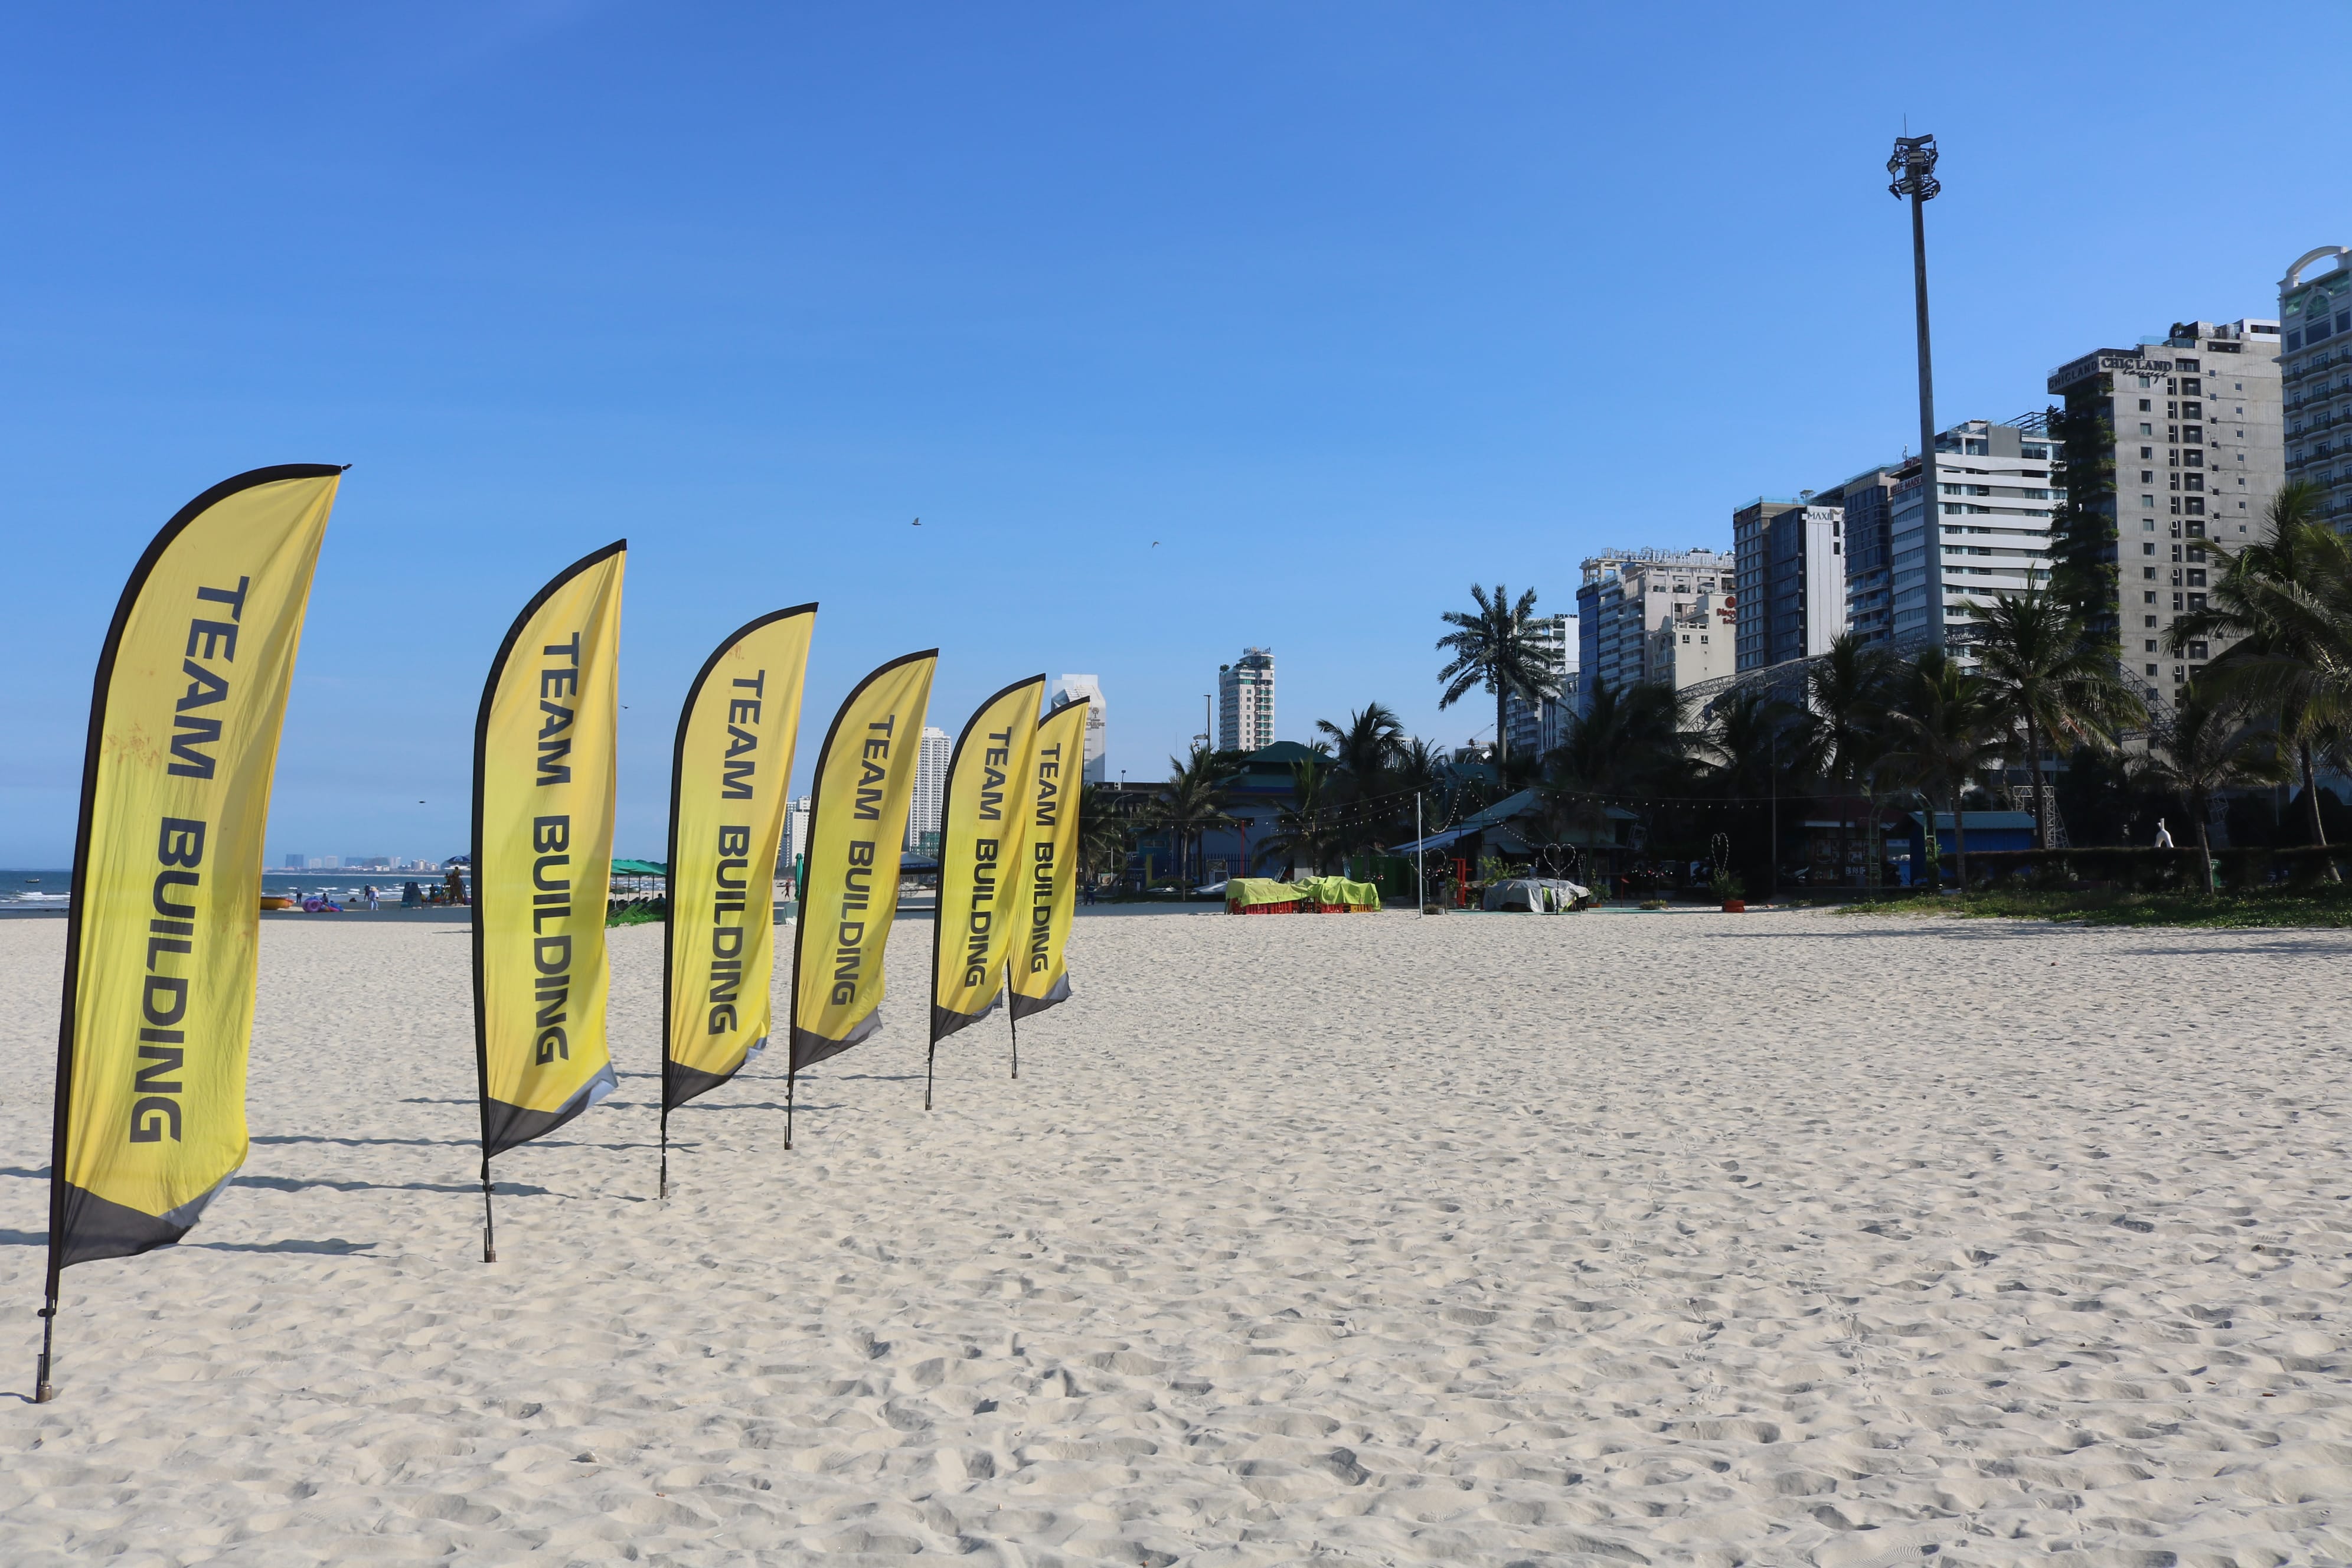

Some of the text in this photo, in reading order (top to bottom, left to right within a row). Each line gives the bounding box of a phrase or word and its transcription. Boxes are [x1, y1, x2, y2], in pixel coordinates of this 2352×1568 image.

[1890, 483, 1904, 495] BELLE
[1905, 476, 1922, 489] MAISO
[2102, 357, 2173, 373] CHIC LAND
[130, 576, 250, 1142] TEAM BUILDING
[533, 632, 579, 1066] TEAM BUILDING
[708, 670, 765, 1035] TEAM BUILDING
[831, 715, 894, 1005] TEAM BUILDING
[964, 727, 1012, 987] TEAM BUILDING
[1031, 743, 1060, 973] TEAM BUILDING
